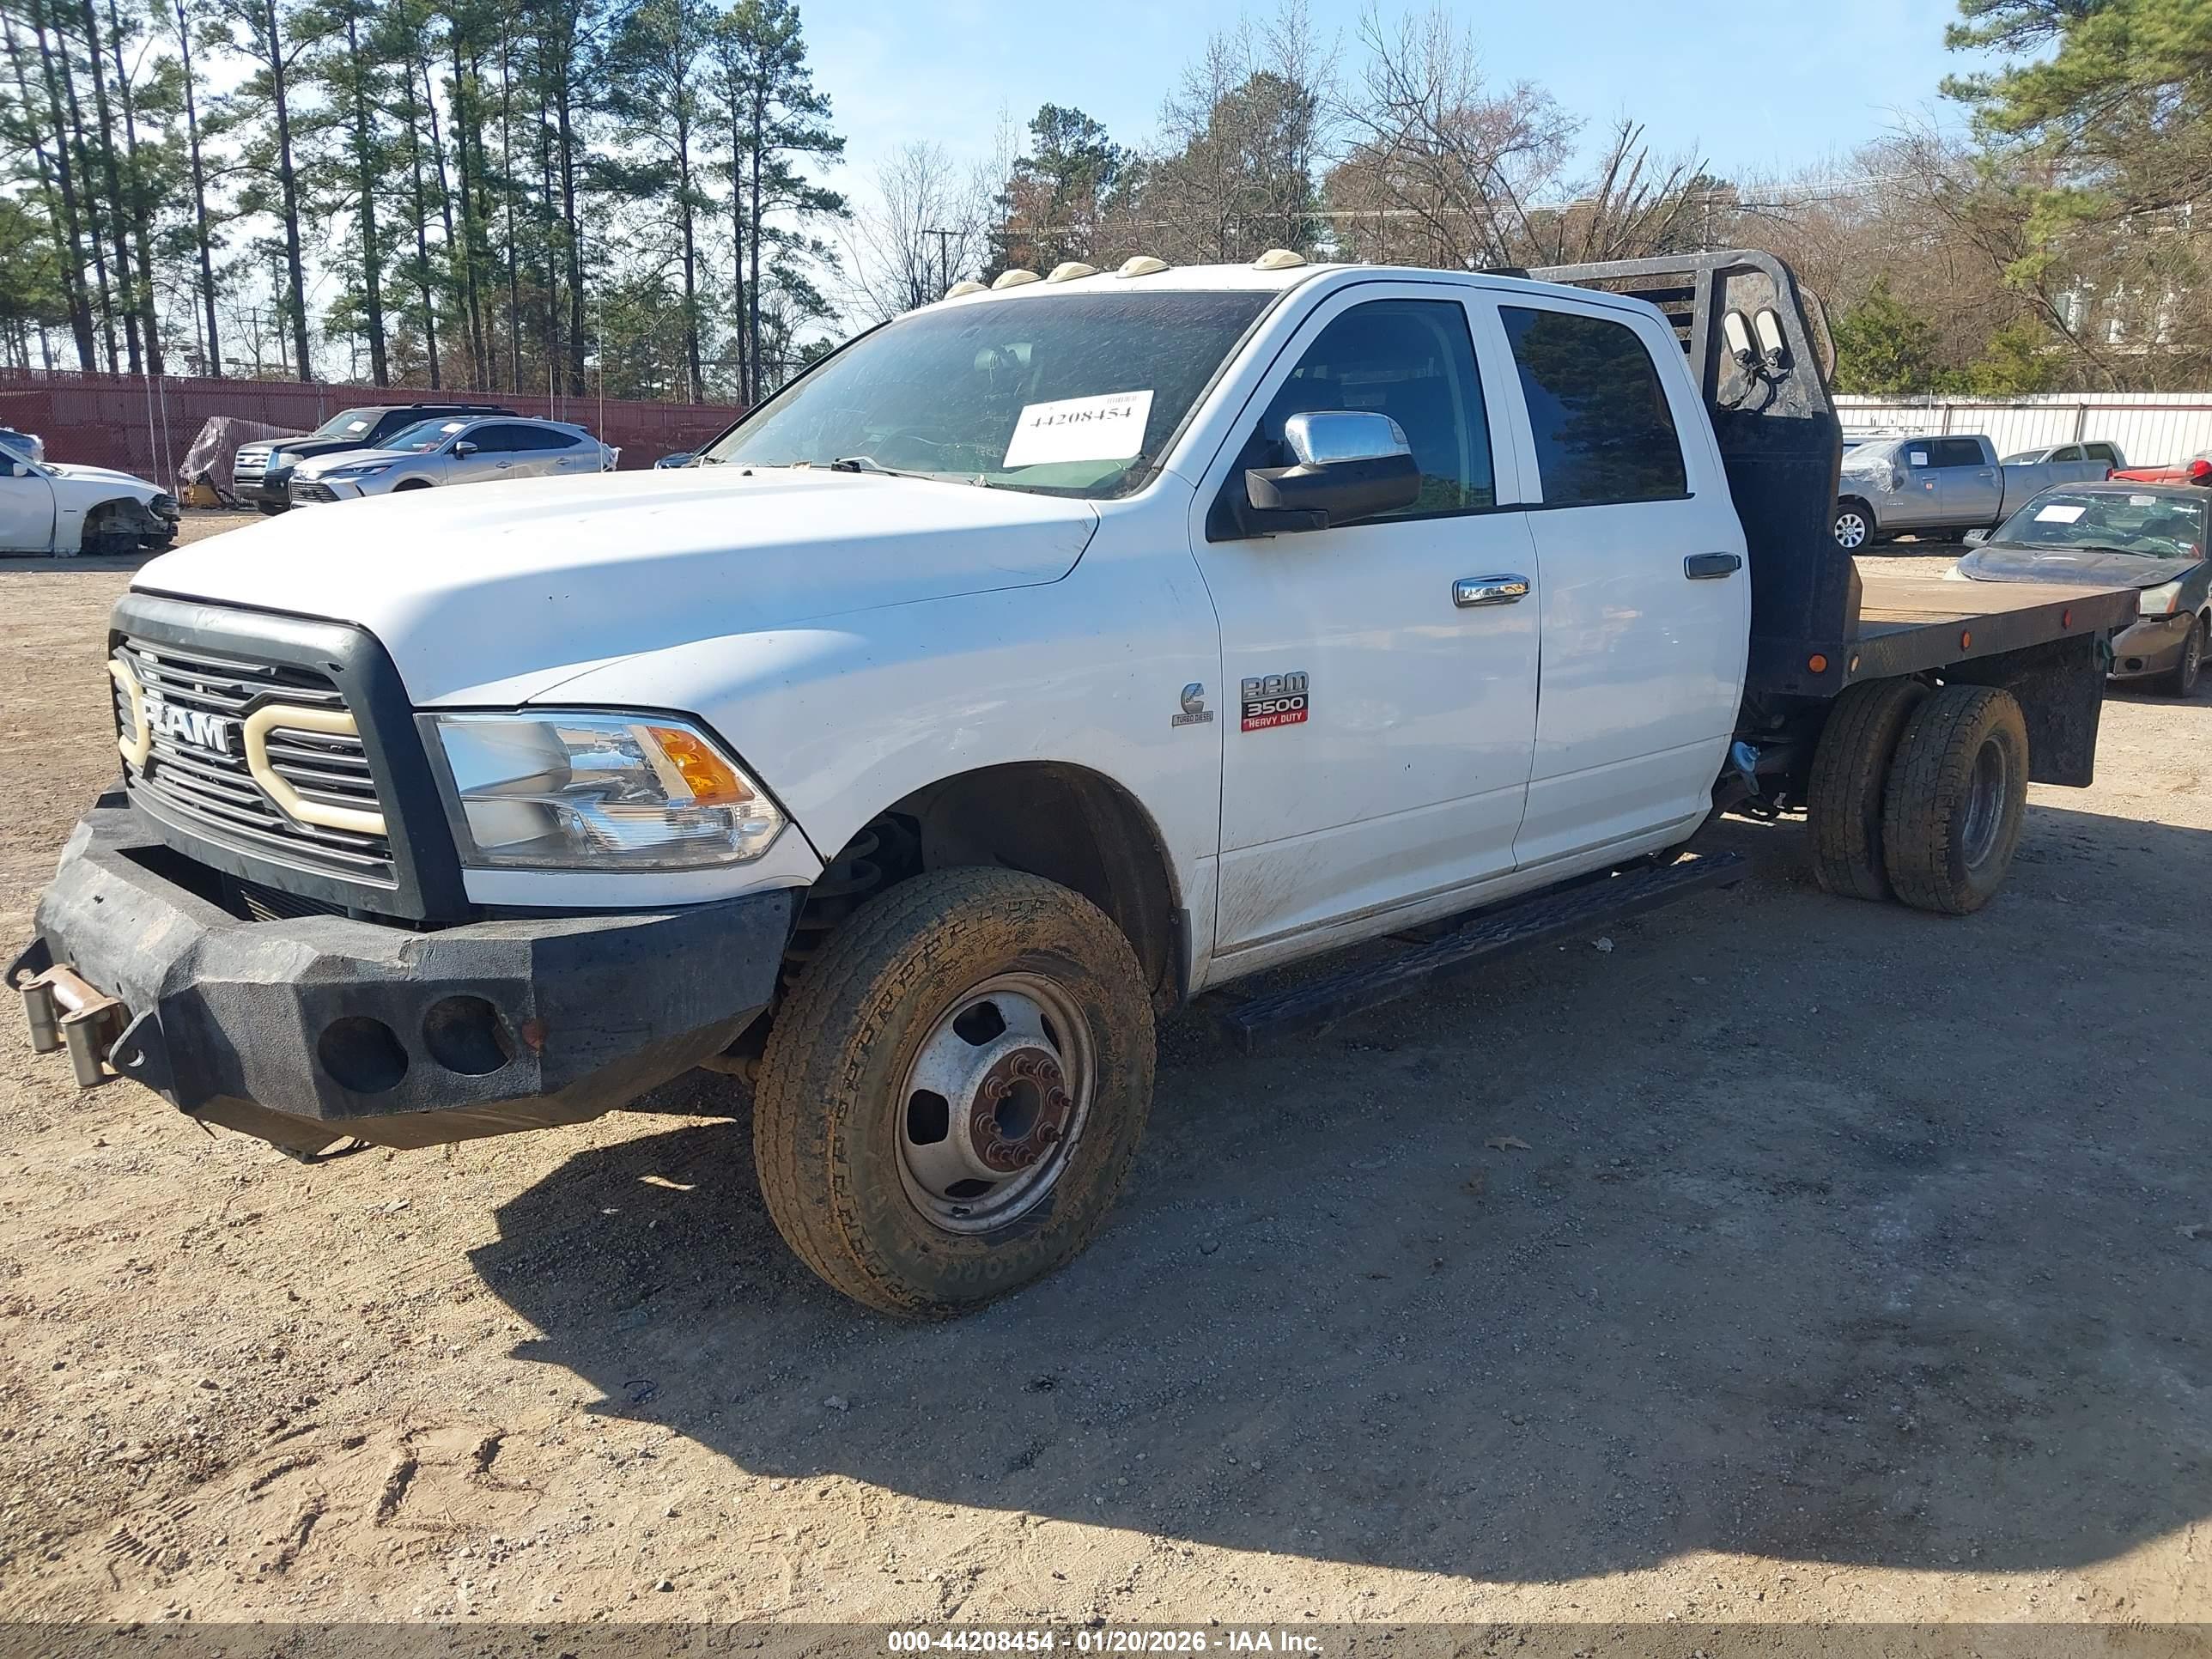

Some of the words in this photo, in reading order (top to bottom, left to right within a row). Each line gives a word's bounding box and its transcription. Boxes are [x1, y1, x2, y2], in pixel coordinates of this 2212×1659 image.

[1030, 406, 1132, 428] 44208454
[1242, 672, 1309, 698] RAM
[1248, 696, 1304, 717] 3500
[139, 697, 230, 754] RAM
[1176, 715, 1194, 724] TURBO
[1194, 713, 1213, 722] DIESEL
[1249, 717, 1278, 728] HEAVY
[1280, 712, 1303, 723] DUTY
